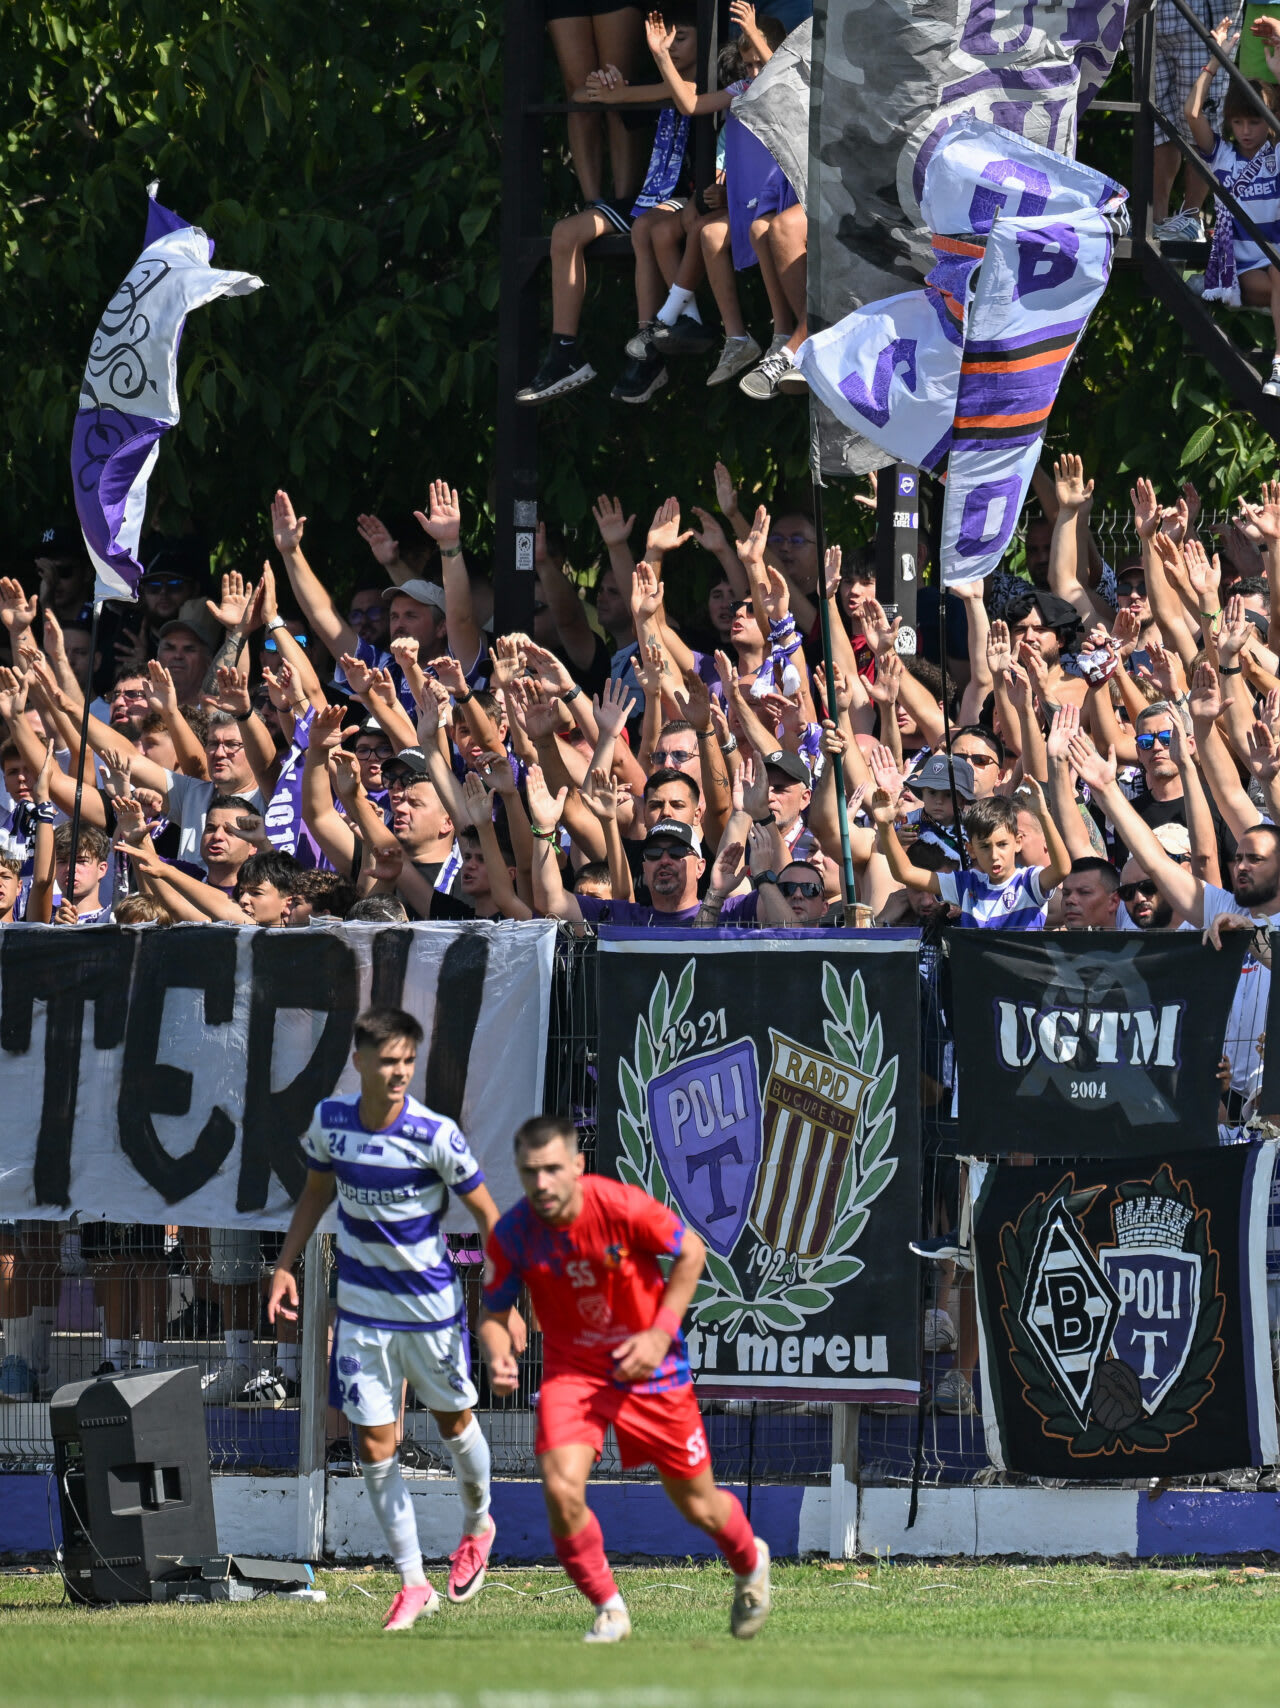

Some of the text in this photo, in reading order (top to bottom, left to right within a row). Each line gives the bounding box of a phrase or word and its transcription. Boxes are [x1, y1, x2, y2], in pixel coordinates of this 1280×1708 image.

[662, 1008, 727, 1059] 1921
[998, 1000, 1181, 1068] UGTM
[786, 1050, 849, 1102] RAPID
[1070, 1081, 1107, 1099] 2004
[668, 1064, 746, 1147] POLI
[328, 1133, 347, 1156] 24
[686, 1136, 744, 1221] T
[746, 1242, 798, 1285] 1923
[1118, 1268, 1181, 1320] POLI
[736, 1332, 888, 1374] mereu
[1130, 1328, 1168, 1380] T
